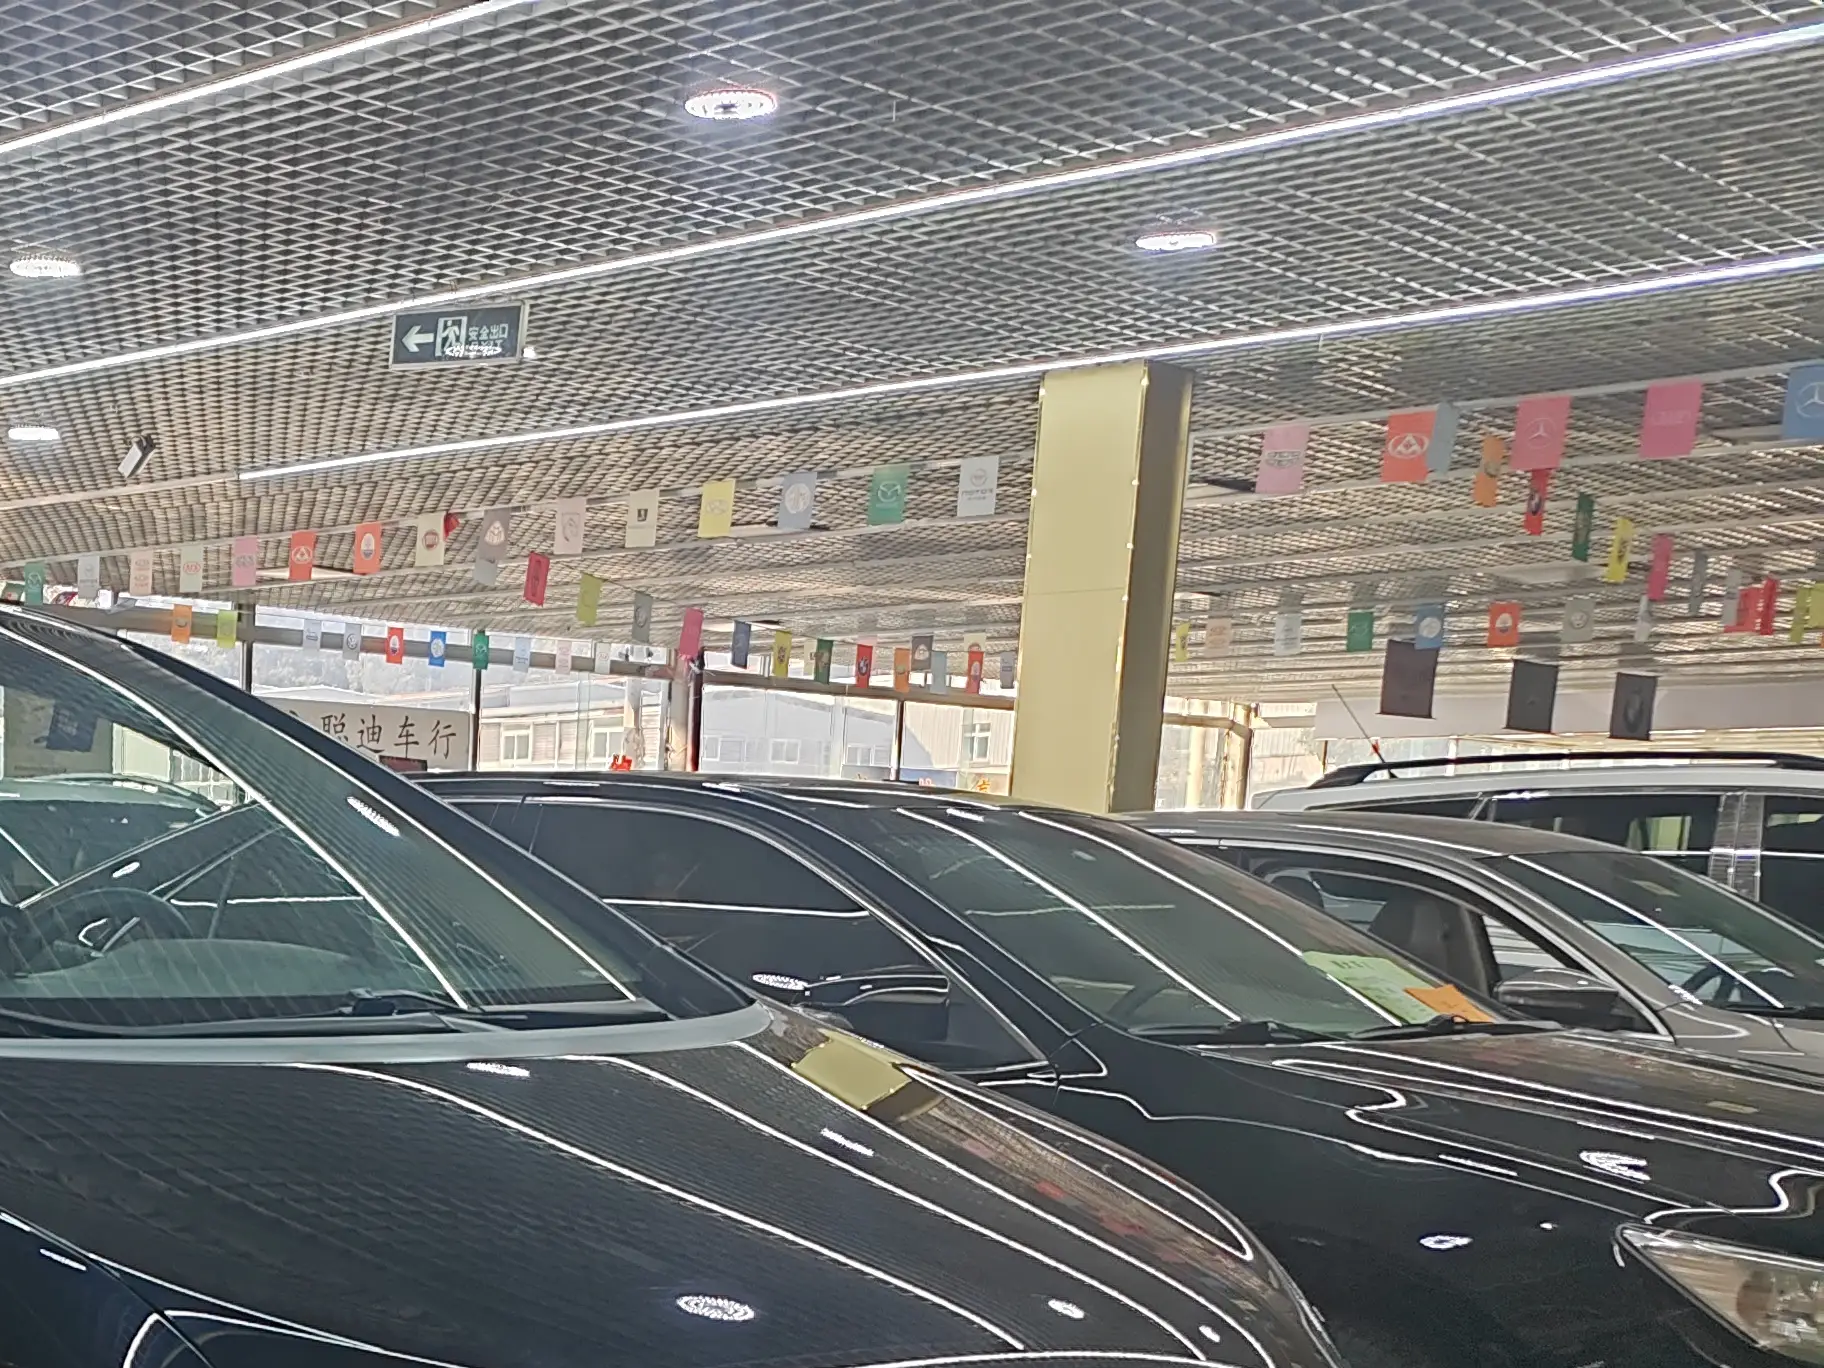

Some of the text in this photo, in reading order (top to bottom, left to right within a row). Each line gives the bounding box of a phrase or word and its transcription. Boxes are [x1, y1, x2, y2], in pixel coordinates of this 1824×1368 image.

[467, 323, 509, 341] 安全出口
[289, 710, 457, 759] 聪迪车行
